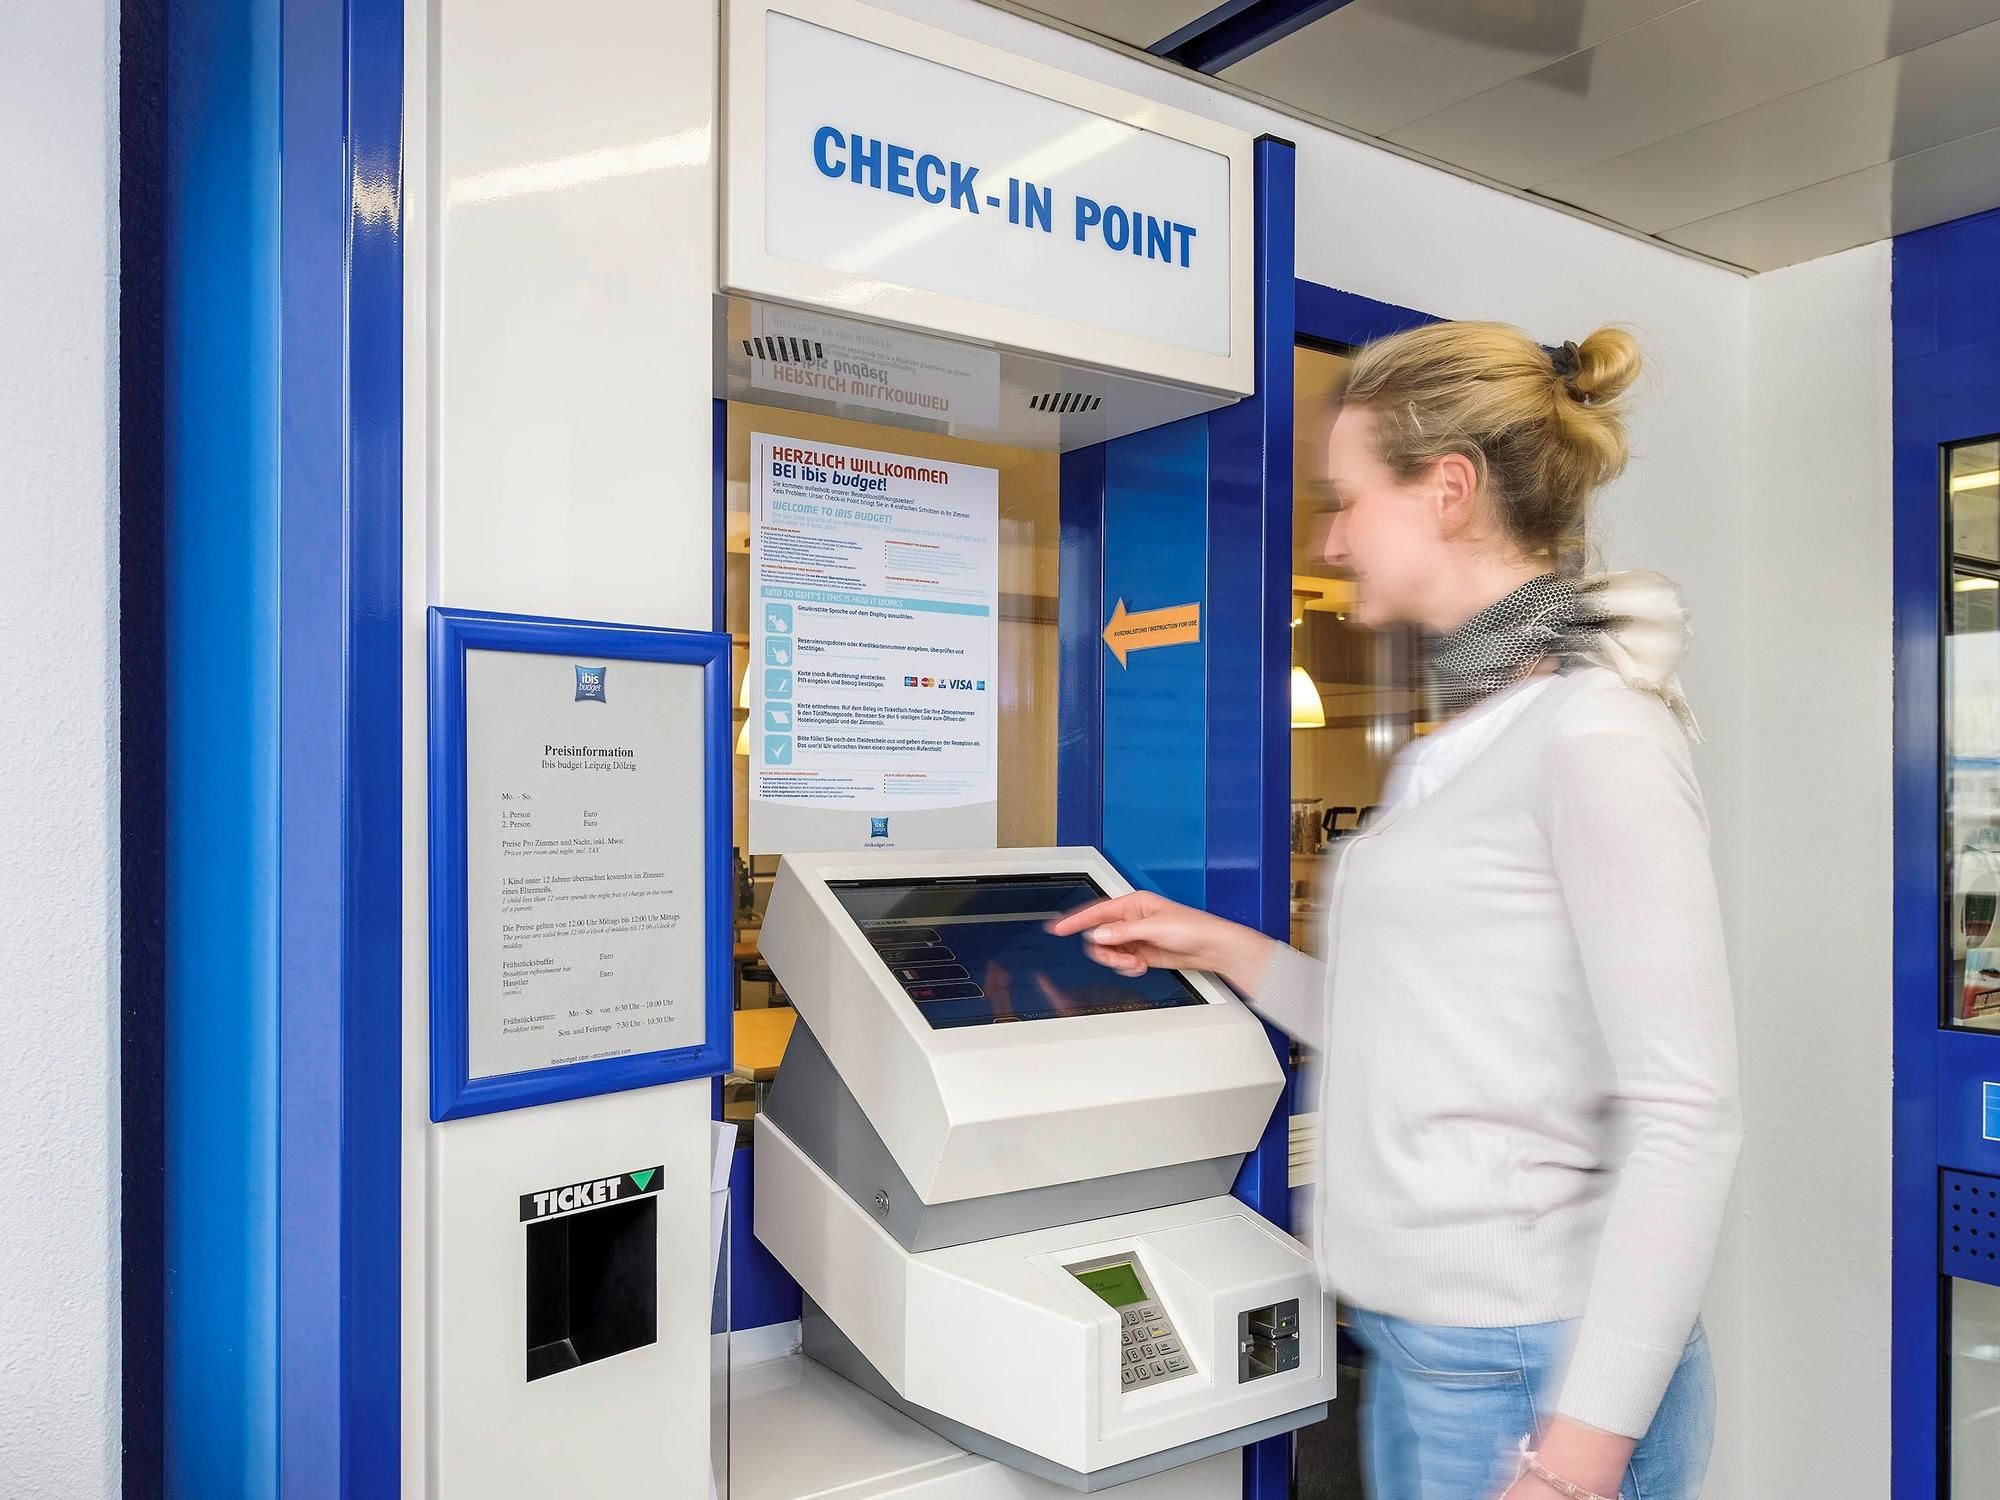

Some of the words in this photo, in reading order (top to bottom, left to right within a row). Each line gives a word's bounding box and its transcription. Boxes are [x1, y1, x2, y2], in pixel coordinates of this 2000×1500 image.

[813, 126, 1052, 232] CHECK-IN
[1075, 196, 1197, 268] POINT
[772, 446, 845, 469] HERZLICH
[850, 457, 948, 483] WILLKOMMEN
[772, 462, 796, 479] BEI
[801, 466, 827, 483] ibis
[832, 470, 887, 491] budget!
[782, 481, 804, 490] kommen
[805, 485, 830, 493] außerhalb
[773, 486, 785, 494] Kein
[808, 491, 824, 499] Unser
[825, 493, 846, 502] Check-in
[918, 505, 940, 514] Schritten
[773, 500, 819, 514] WELCOME
[820, 506, 833, 516] TO
[834, 508, 853, 518] IBIS
[854, 510, 892, 523] BUDGET!
[765, 588, 783, 596] UND
[784, 589, 794, 597] SO
[827, 593, 841, 602] THIS
[879, 598, 904, 607] WORKS
[798, 605, 828, 613] Gewünschte
[829, 607, 848, 615] Sprache
[869, 610, 887, 619] Display
[1114, 627, 1147, 637] KURZANLEITUNG
[1150, 624, 1178, 632] INSTRUCTION
[798, 637, 846, 647] Reservierungsdaten
[859, 641, 906, 650] Kreditkartennummer
[930, 646, 954, 654] überprüfen
[582, 673, 599, 683] ibis
[807, 677, 830, 685] eingeben
[841, 678, 857, 687] Betrag
[579, 682, 601, 692] budget
[949, 680, 973, 690] VISA
[863, 705, 876, 713] Beleg
[544, 745, 634, 757] Preisinformation
[542, 760, 556, 768] Ibis
[557, 760, 582, 771] budget
[584, 761, 611, 771] Leipzig
[613, 761, 636, 772] Dölzig
[606, 872, 632, 880] kostenlos
[516, 922, 534, 930] Preise
[536, 921, 554, 931] gelten
[569, 918, 585, 926] 12:00
[599, 917, 618, 925] Mittags
[621, 915, 630, 923] bis
[631, 914, 647, 922] 12:00
[648, 913, 659, 921] Uhr
[660, 913, 680, 921] Mittags
[600, 970, 614, 978] Euro
[503, 978, 529, 986] Haustier
[615, 1004, 628, 1012] 6:30
[646, 1000, 662, 1008] 10:00
[573, 1026, 584, 1034] und
[585, 1025, 611, 1033] Feiertags
[616, 1021, 629, 1029] 7:30
[647, 1017, 663, 1025] 10:30
[664, 1015, 674, 1023] Uhr
[551, 1054, 589, 1064] ibisbudget.com
[533, 1177, 621, 1216] TICKET
[1128, 1313, 1136, 1321] 3
[1138, 1330, 1145, 1338] 6
[1131, 1350, 1138, 1358] 8
[1146, 1347, 1153, 1355] 9
[1140, 1368, 1147, 1376] 0
